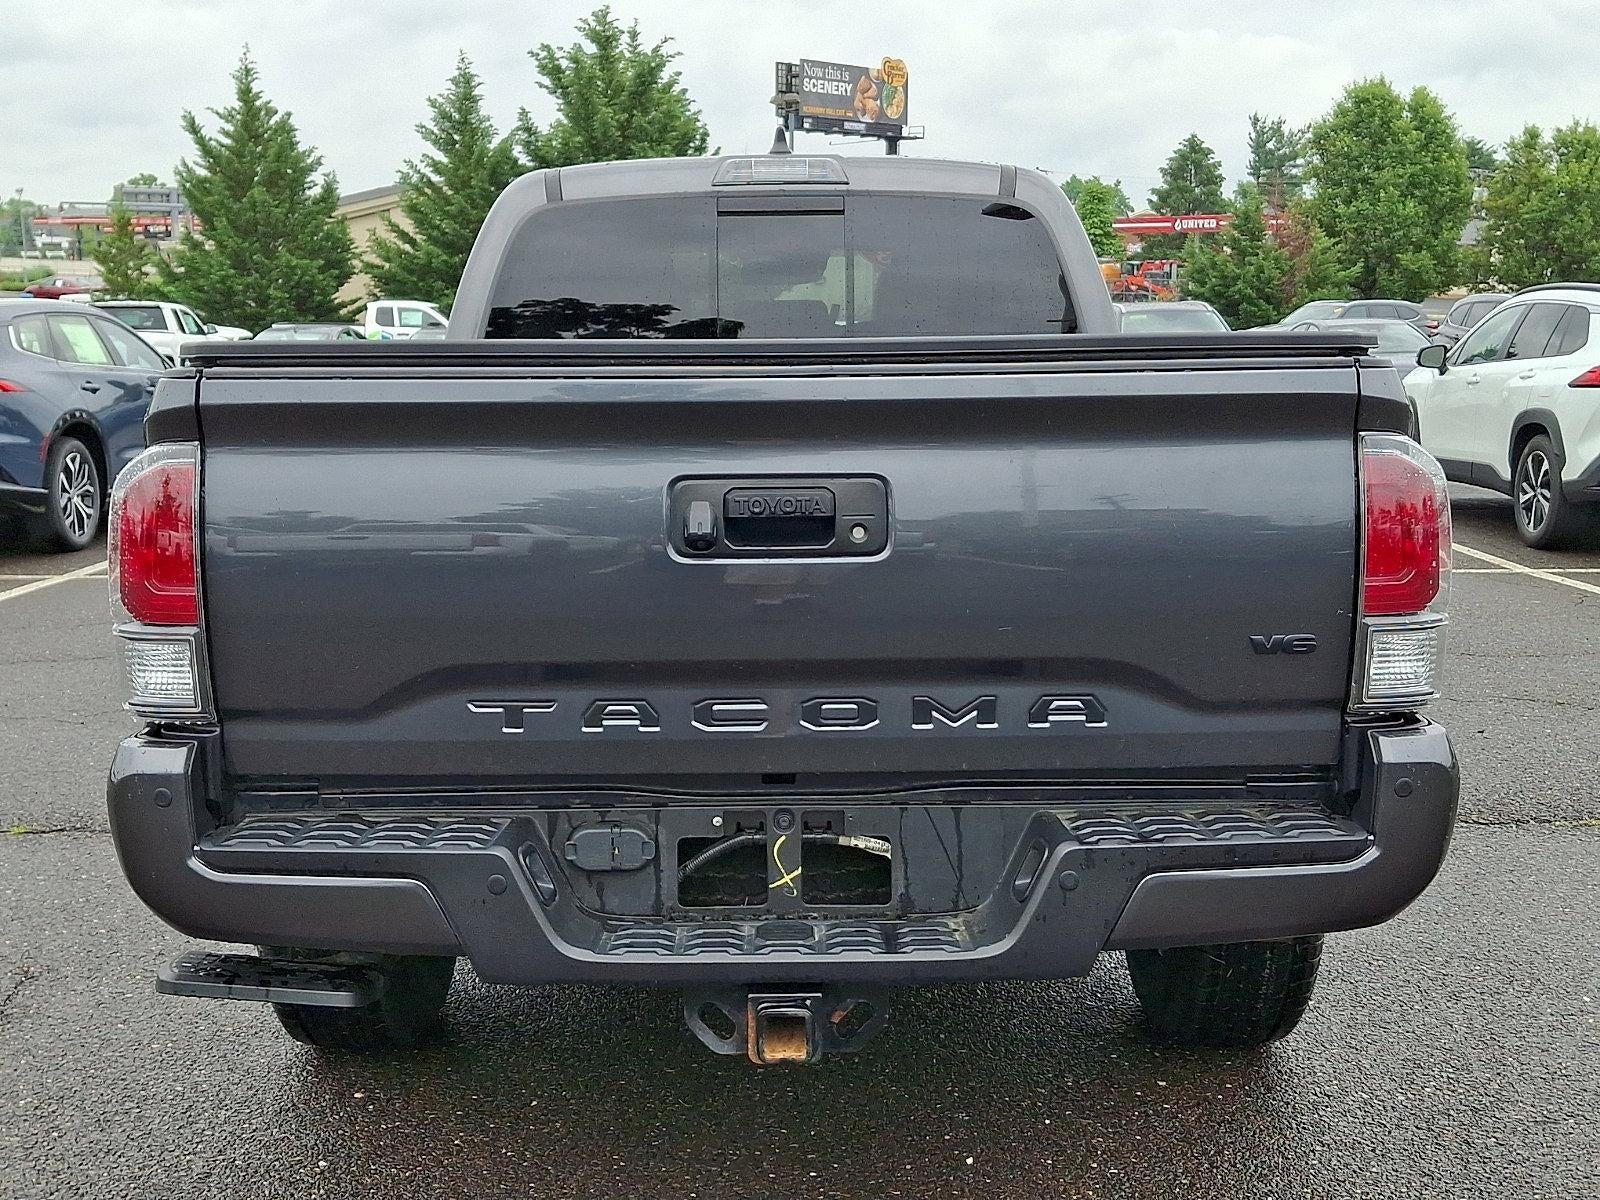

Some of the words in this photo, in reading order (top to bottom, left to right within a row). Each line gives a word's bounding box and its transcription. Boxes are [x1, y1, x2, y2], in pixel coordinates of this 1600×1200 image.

[803, 62, 824, 78] Now
[825, 65, 841, 80] this
[842, 67, 850, 81] is
[803, 78, 852, 96] SCENERY
[1182, 219, 1216, 228] UNITED
[734, 496, 827, 516] TOYOTA
[1248, 633, 1318, 655] V6
[466, 694, 1108, 734] TACOMA
